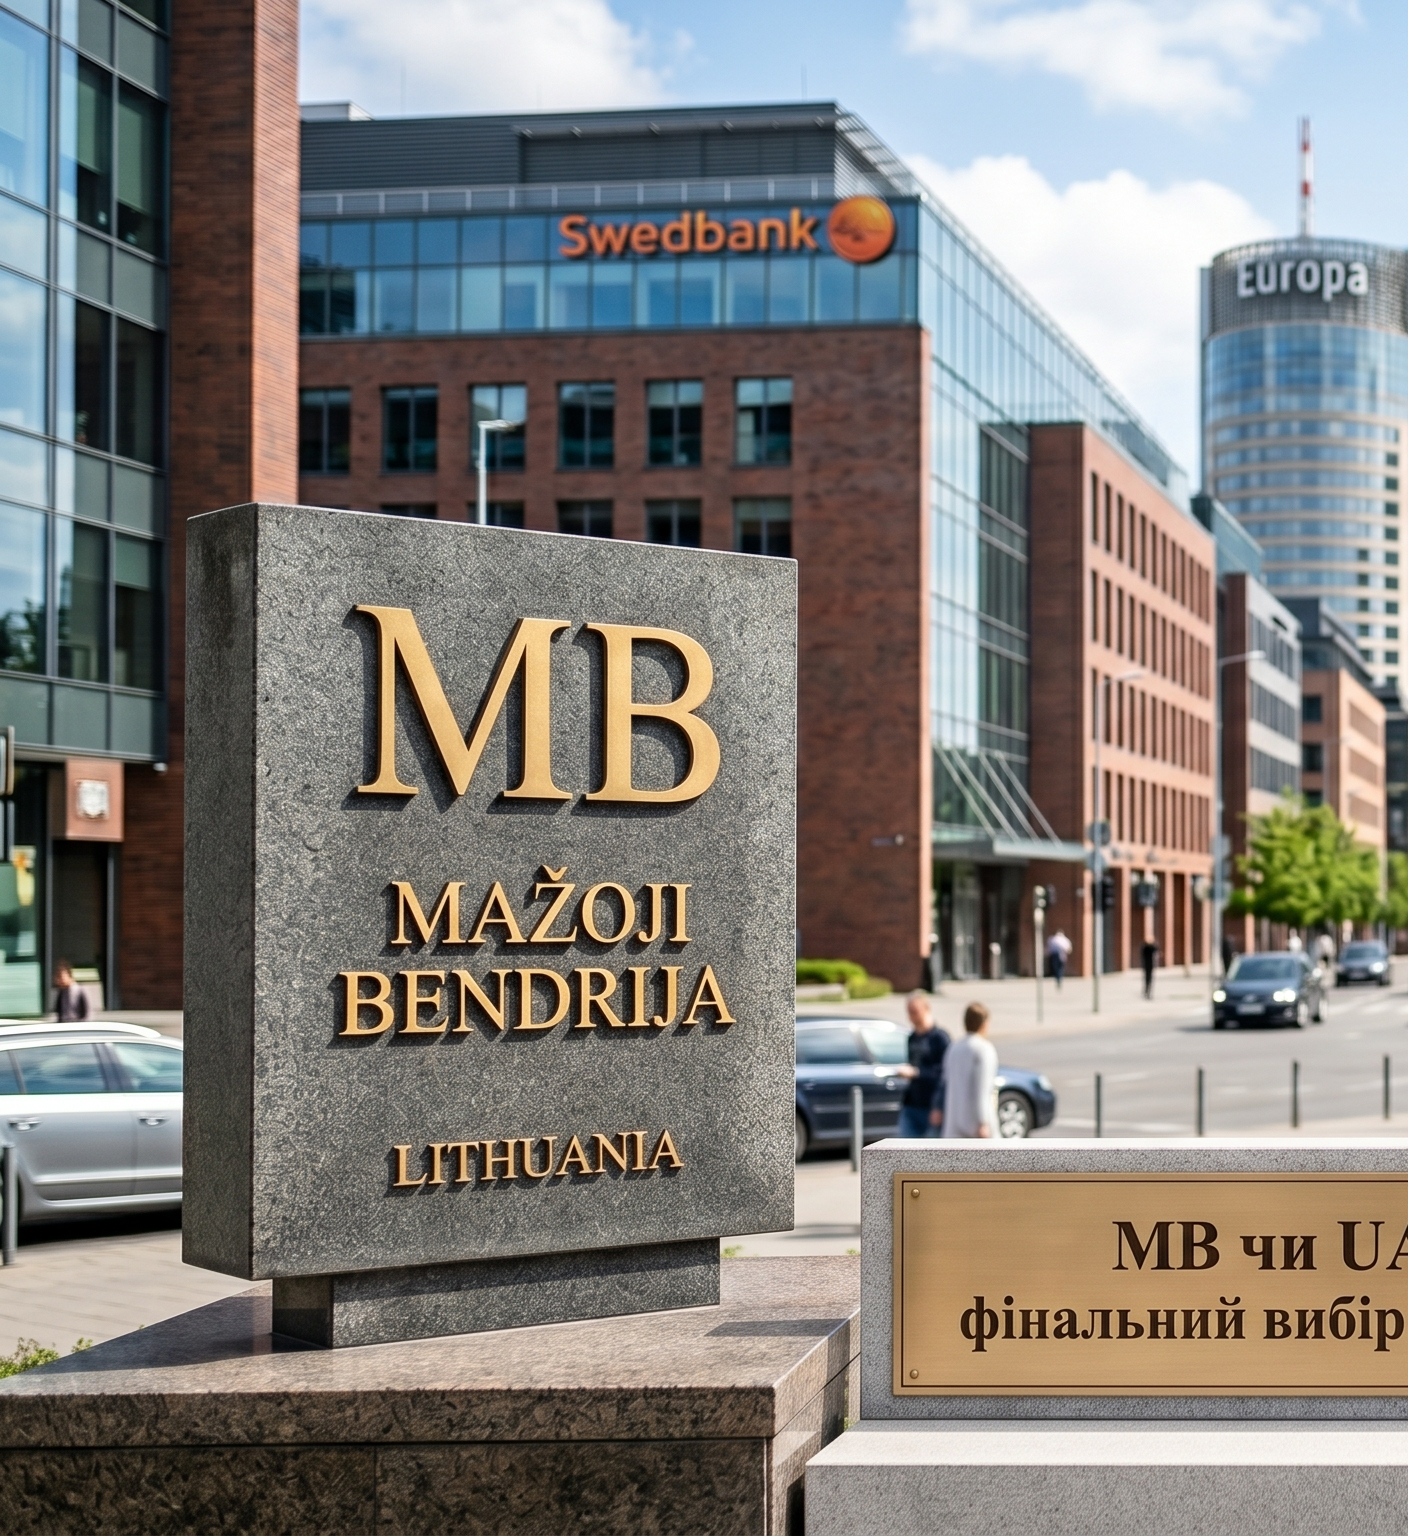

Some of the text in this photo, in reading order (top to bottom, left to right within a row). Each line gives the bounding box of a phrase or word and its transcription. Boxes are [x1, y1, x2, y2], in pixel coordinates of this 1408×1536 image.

[558, 207, 819, 257] Swedbank
[1237, 259, 1369, 301] Europa
[354, 605, 721, 802] MB
[390, 865, 692, 944] MAŽOJI
[339, 964, 736, 1035] BENDRIJA
[393, 1129, 684, 1186] LITHUANIA
[1112, 1221, 1220, 1270] MB
[1240, 1235, 1317, 1270] чи
[960, 1295, 1246, 1352] фінальний
[1263, 1295, 1405, 1352] вибір
